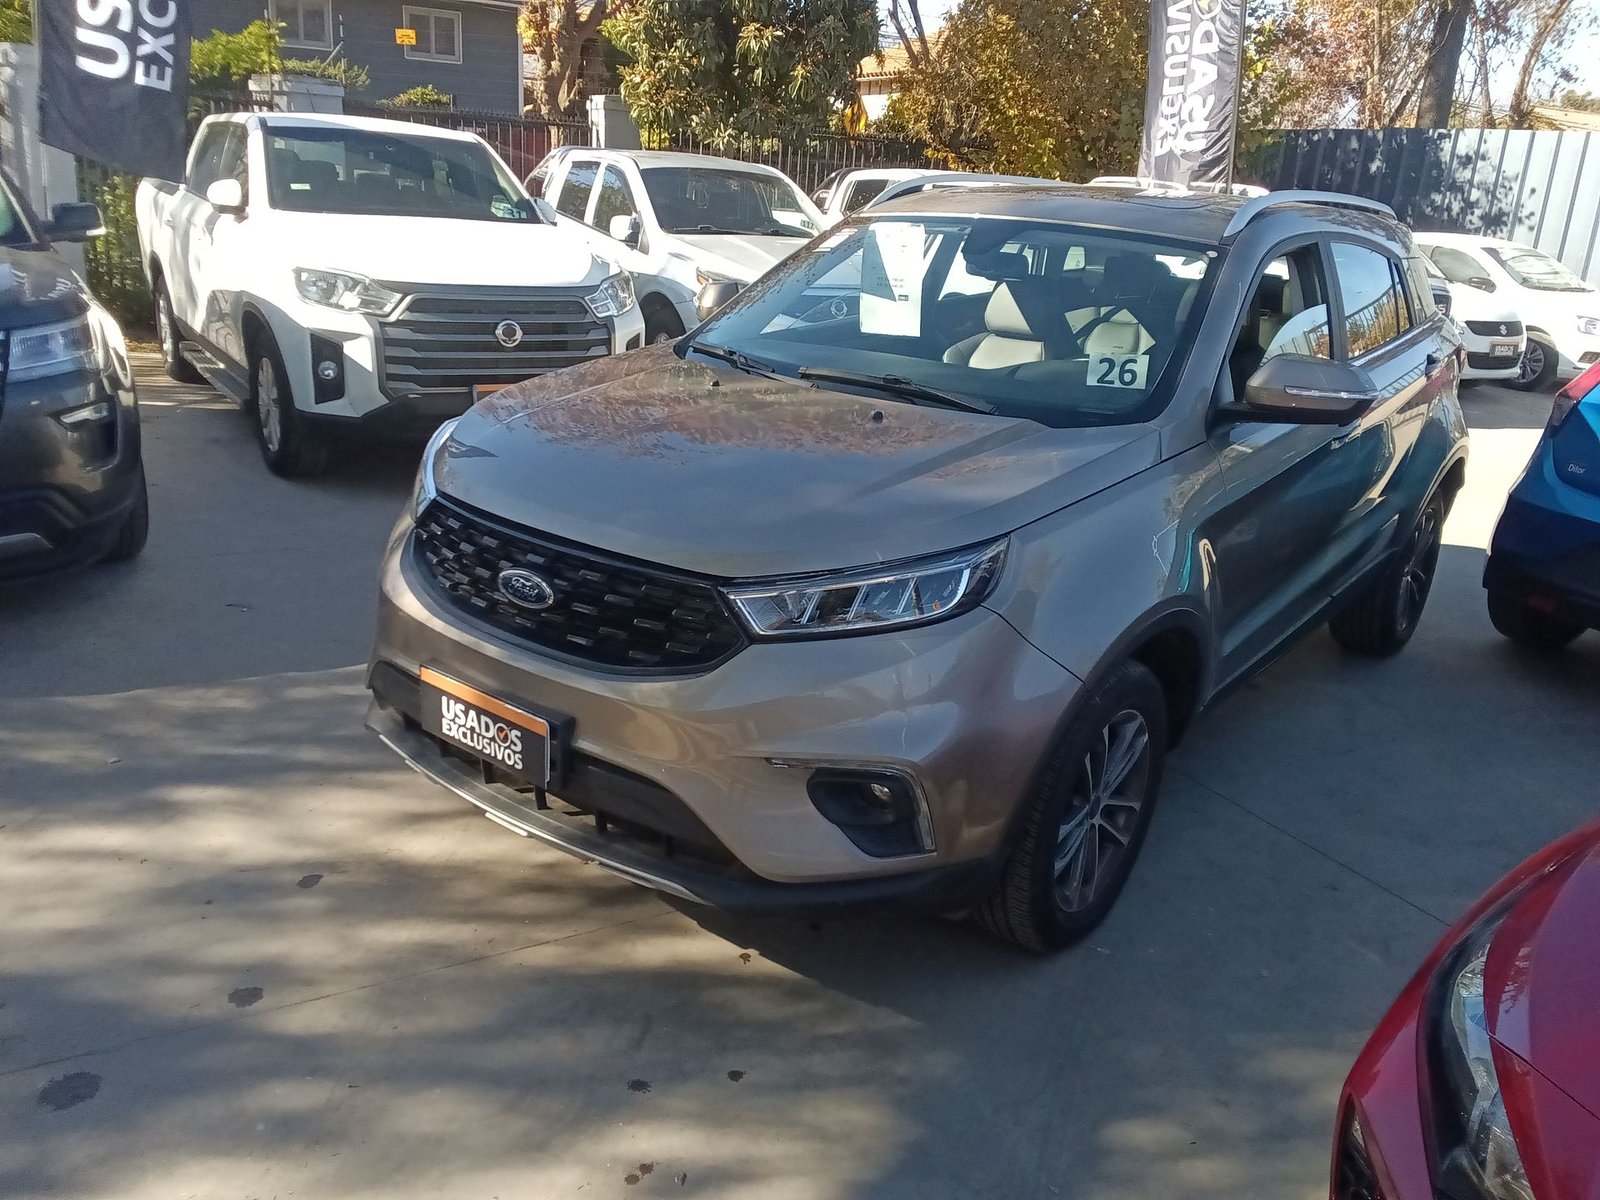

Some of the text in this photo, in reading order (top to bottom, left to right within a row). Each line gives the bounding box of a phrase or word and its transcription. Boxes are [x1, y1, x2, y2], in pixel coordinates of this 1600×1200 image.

[1096, 357, 1138, 386] 26
[441, 695, 522, 752] USADOS
[441, 718, 523, 770] EXCLUSIVOS
